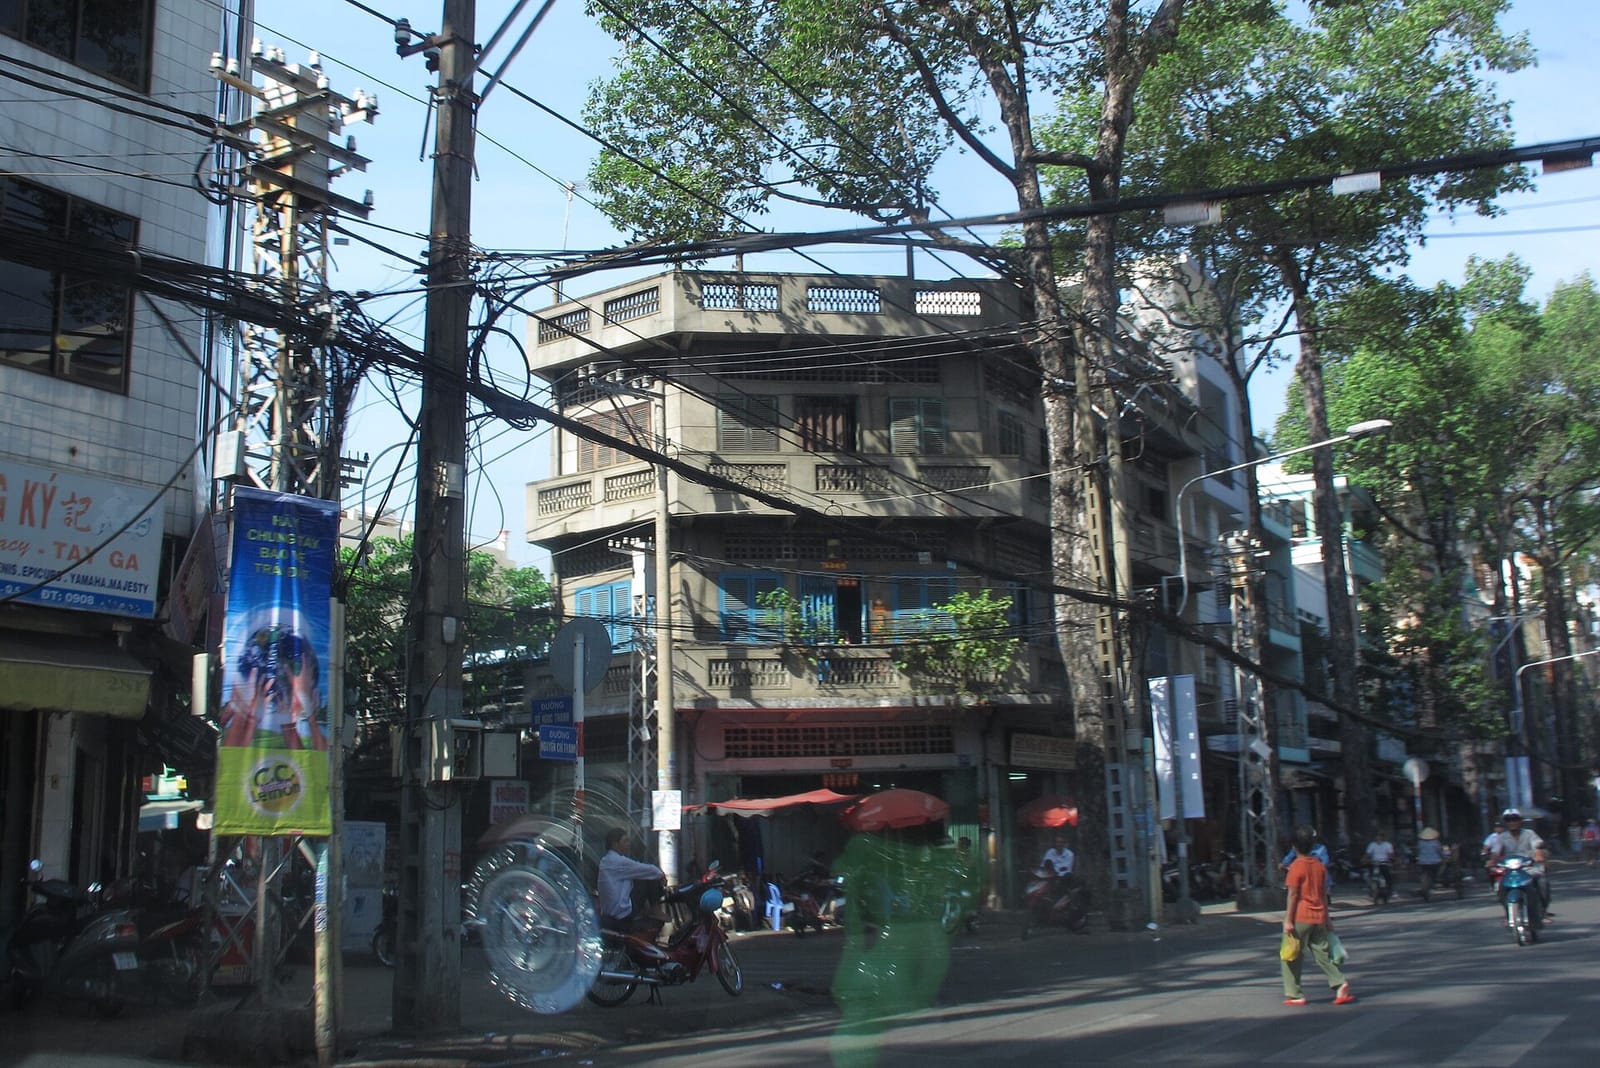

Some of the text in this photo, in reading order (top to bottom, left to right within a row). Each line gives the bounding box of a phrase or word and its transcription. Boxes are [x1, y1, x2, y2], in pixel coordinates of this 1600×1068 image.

[19, 472, 58, 529] KÝ
[60, 490, 94, 533] 記
[53, 540, 98, 566] TAY
[109, 550, 140, 572] GA
[65, 592, 95, 606] 0908
